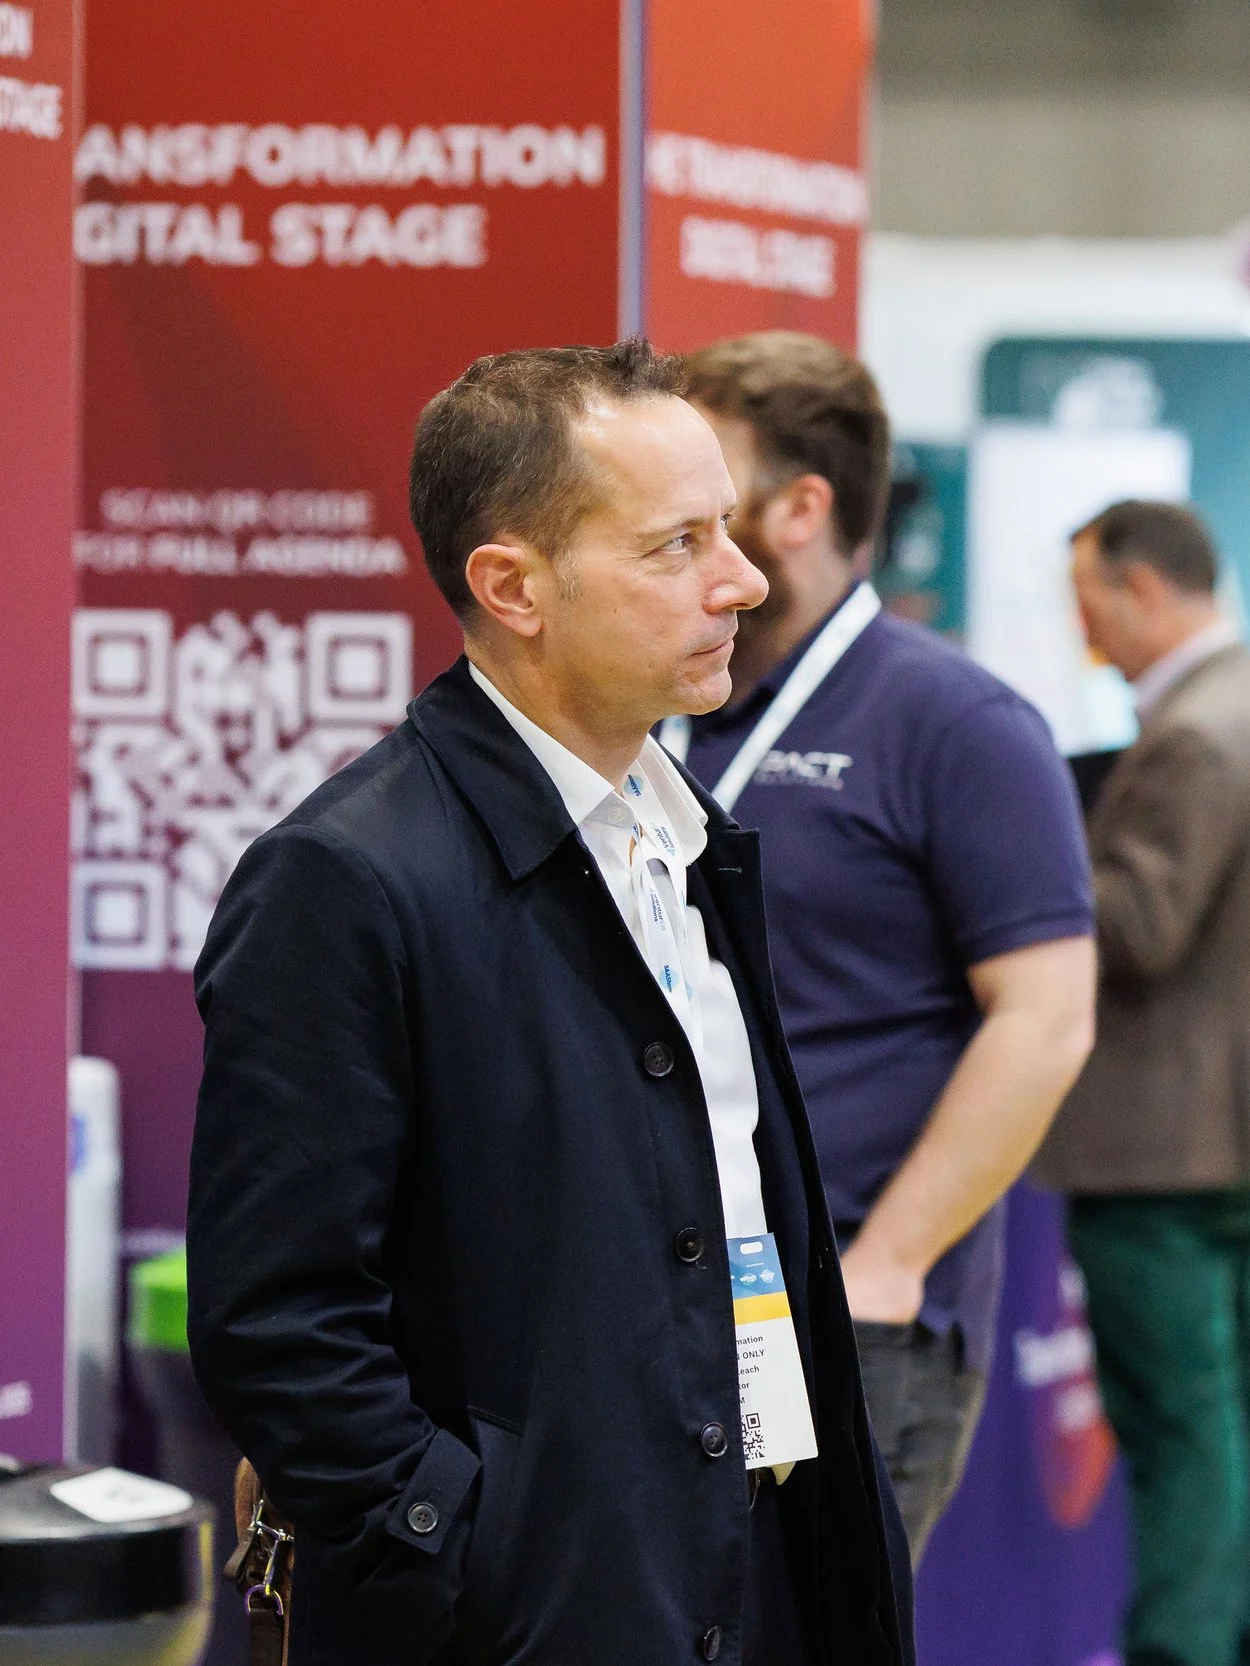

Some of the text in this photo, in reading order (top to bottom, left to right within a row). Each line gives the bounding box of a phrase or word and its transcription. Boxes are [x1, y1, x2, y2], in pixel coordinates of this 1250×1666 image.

[74, 123, 605, 188] ANSFORMATION
[74, 202, 487, 268] GITAL STAGE
[742, 1349, 765, 1360] ONLY
